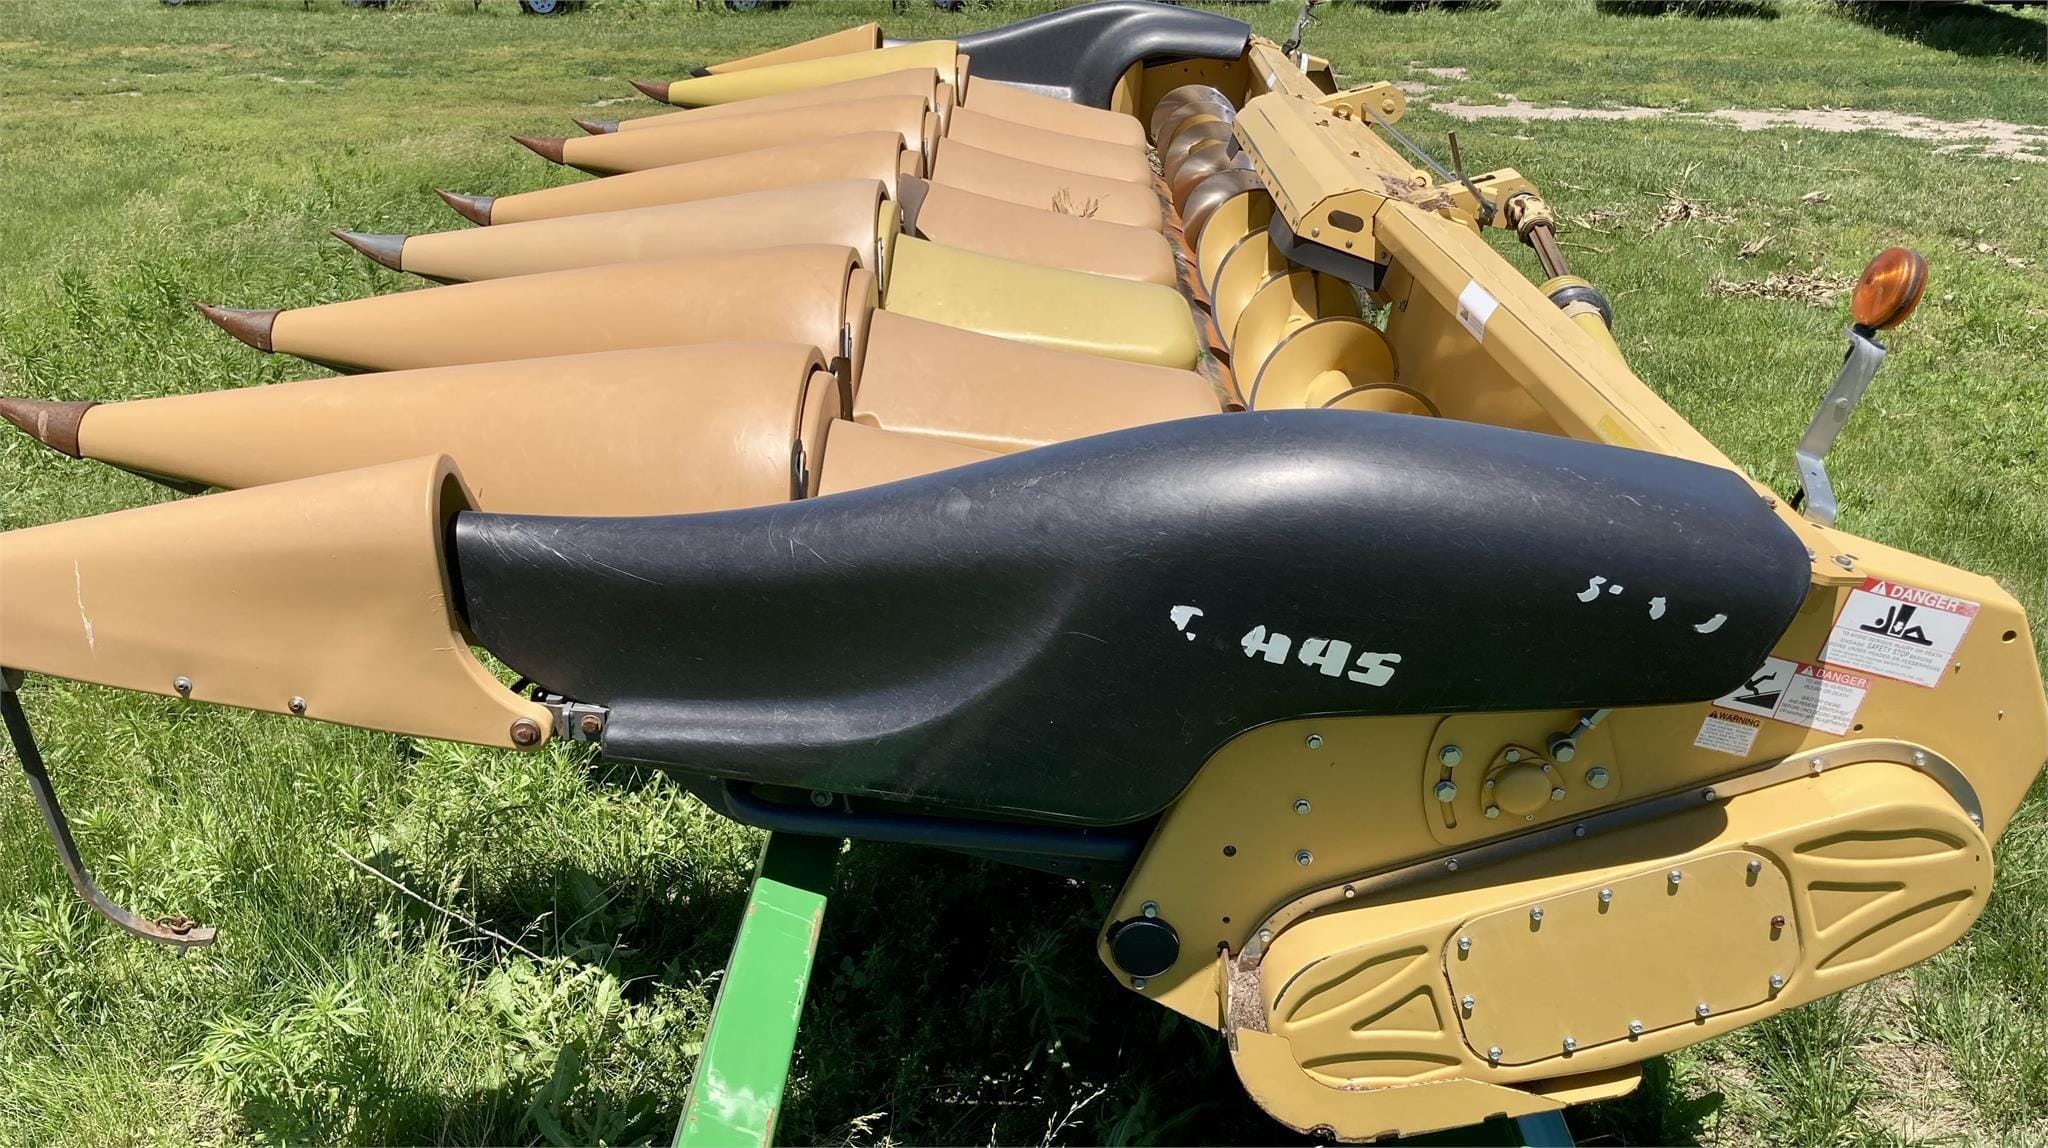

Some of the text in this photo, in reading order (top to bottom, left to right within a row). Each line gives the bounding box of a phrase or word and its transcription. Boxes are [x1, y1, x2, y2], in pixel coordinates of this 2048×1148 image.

[1890, 586, 1960, 612] DANGER
[1866, 641, 1892, 653] SAFETY
[1892, 648, 1910, 658] STOP
[1815, 669, 1867, 688] DANGER
[1719, 711, 1760, 728] WARNING
